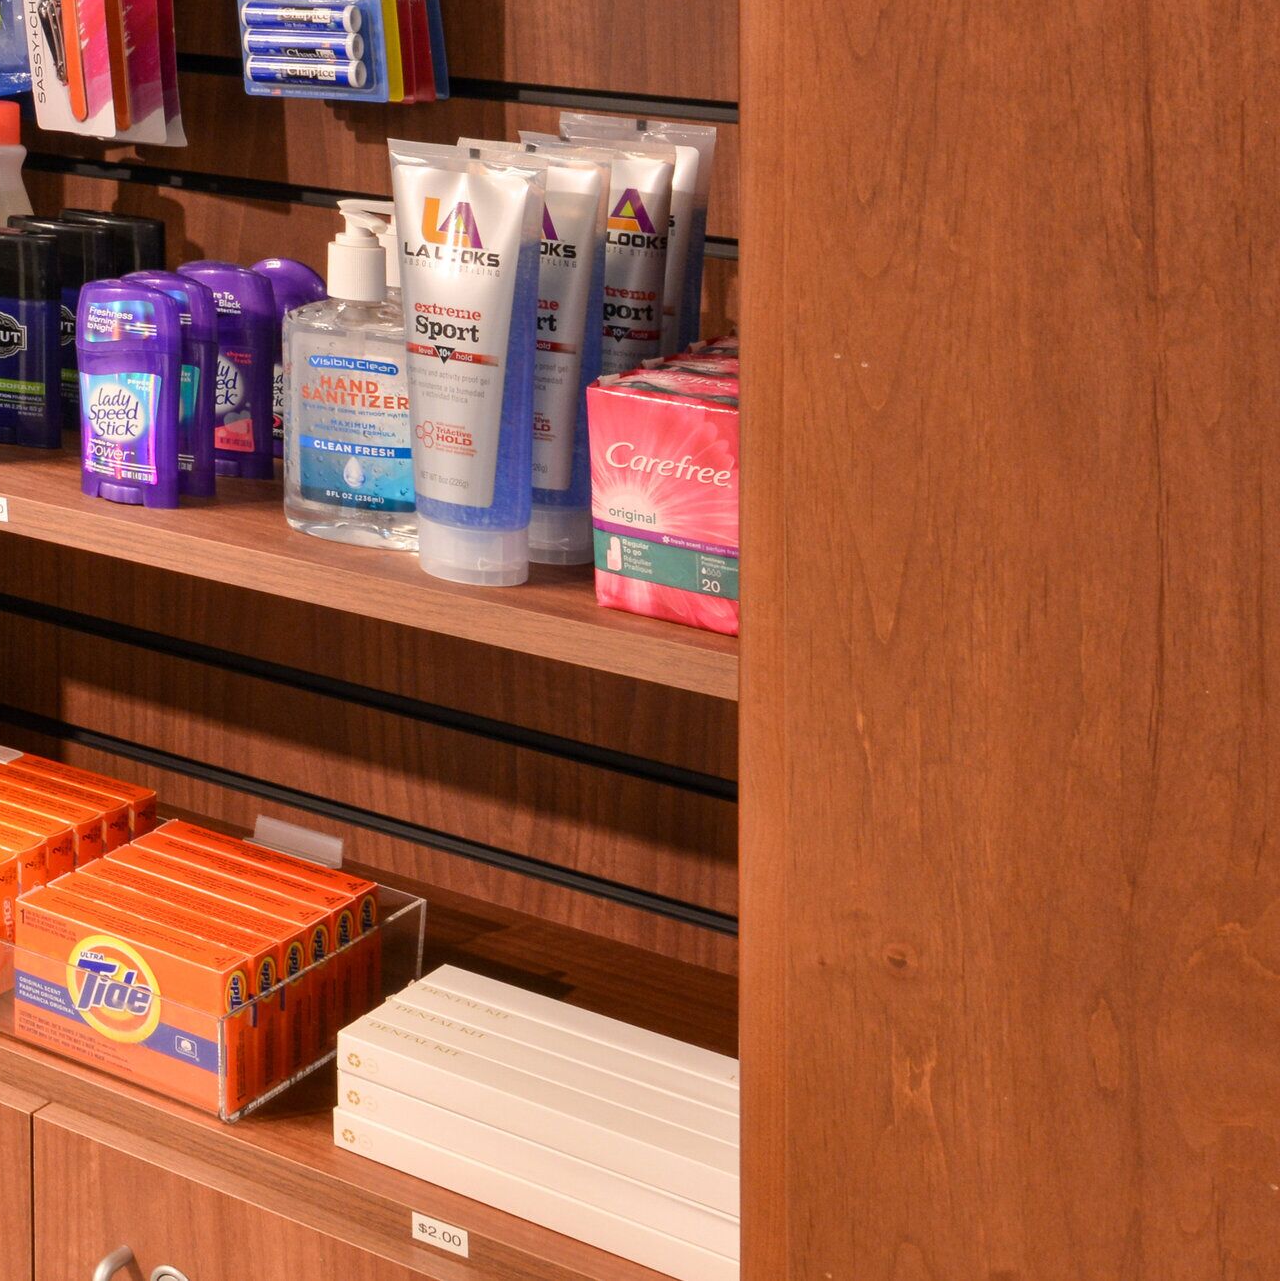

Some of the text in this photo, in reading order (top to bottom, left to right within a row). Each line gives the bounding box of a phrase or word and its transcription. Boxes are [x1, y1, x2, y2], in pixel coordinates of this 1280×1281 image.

[404, 242, 430, 258] LA
[90, 306, 134, 321] Freshness
[415, 302, 482, 321] extreme
[416, 314, 480, 342] Sport
[418, 345, 473, 361] level 10+ hold
[311, 357, 397, 374] Visibly Clean
[320, 375, 379, 394] HAND
[98, 388, 131, 410] lady
[301, 386, 410, 410] SANITIZER
[89, 401, 138, 421] Speed
[95, 420, 137, 437] Stick
[330, 419, 376, 430] MAXIMUM
[436, 426, 472, 438] TriActive
[313, 440, 395, 457] CLEAN FRESH
[436, 434, 472, 446] HOLD
[605, 442, 732, 488] Carefree
[326, 489, 384, 504] 8FL OZ (236ml)
[609, 506, 657, 525] original
[622, 538, 649, 550] Regular
[701, 578, 721, 594] 20
[80, 951, 104, 961] ULTRA
[19, 976, 61, 996] ORIGINAL SCENT
[19, 983, 66, 1005] PARFUM ORIGINAL
[75, 958, 152, 1016] Tide
[19, 989, 75, 1015] FRAGANCIA ORIGINAL
[421, 986, 510, 1019] DENTAL KIT
[396, 1005, 487, 1039] DENTAL KIT
[369, 1022, 462, 1056] DENTAL KIT
[417, 1222, 463, 1248] $2.00
